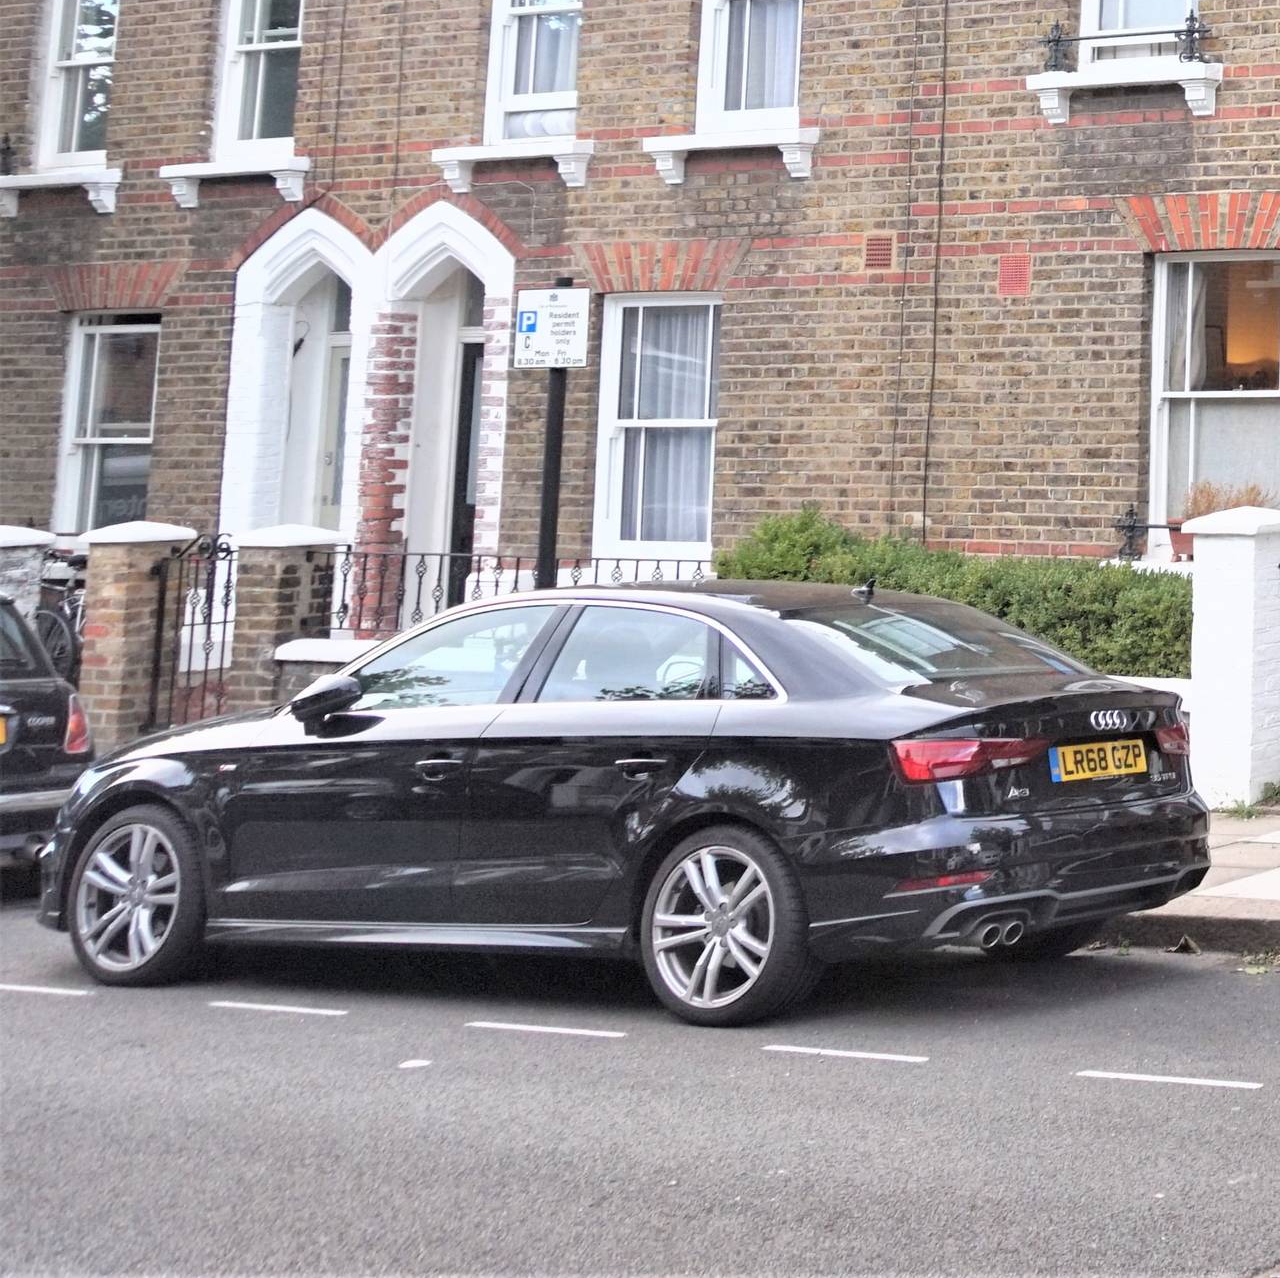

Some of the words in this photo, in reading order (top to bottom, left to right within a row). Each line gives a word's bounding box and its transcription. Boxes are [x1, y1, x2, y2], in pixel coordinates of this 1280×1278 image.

[524, 335, 531, 349] C
[1062, 747, 1108, 776] LR68
[1112, 744, 1142, 769] GZP
[1008, 786, 1030, 798] A3
